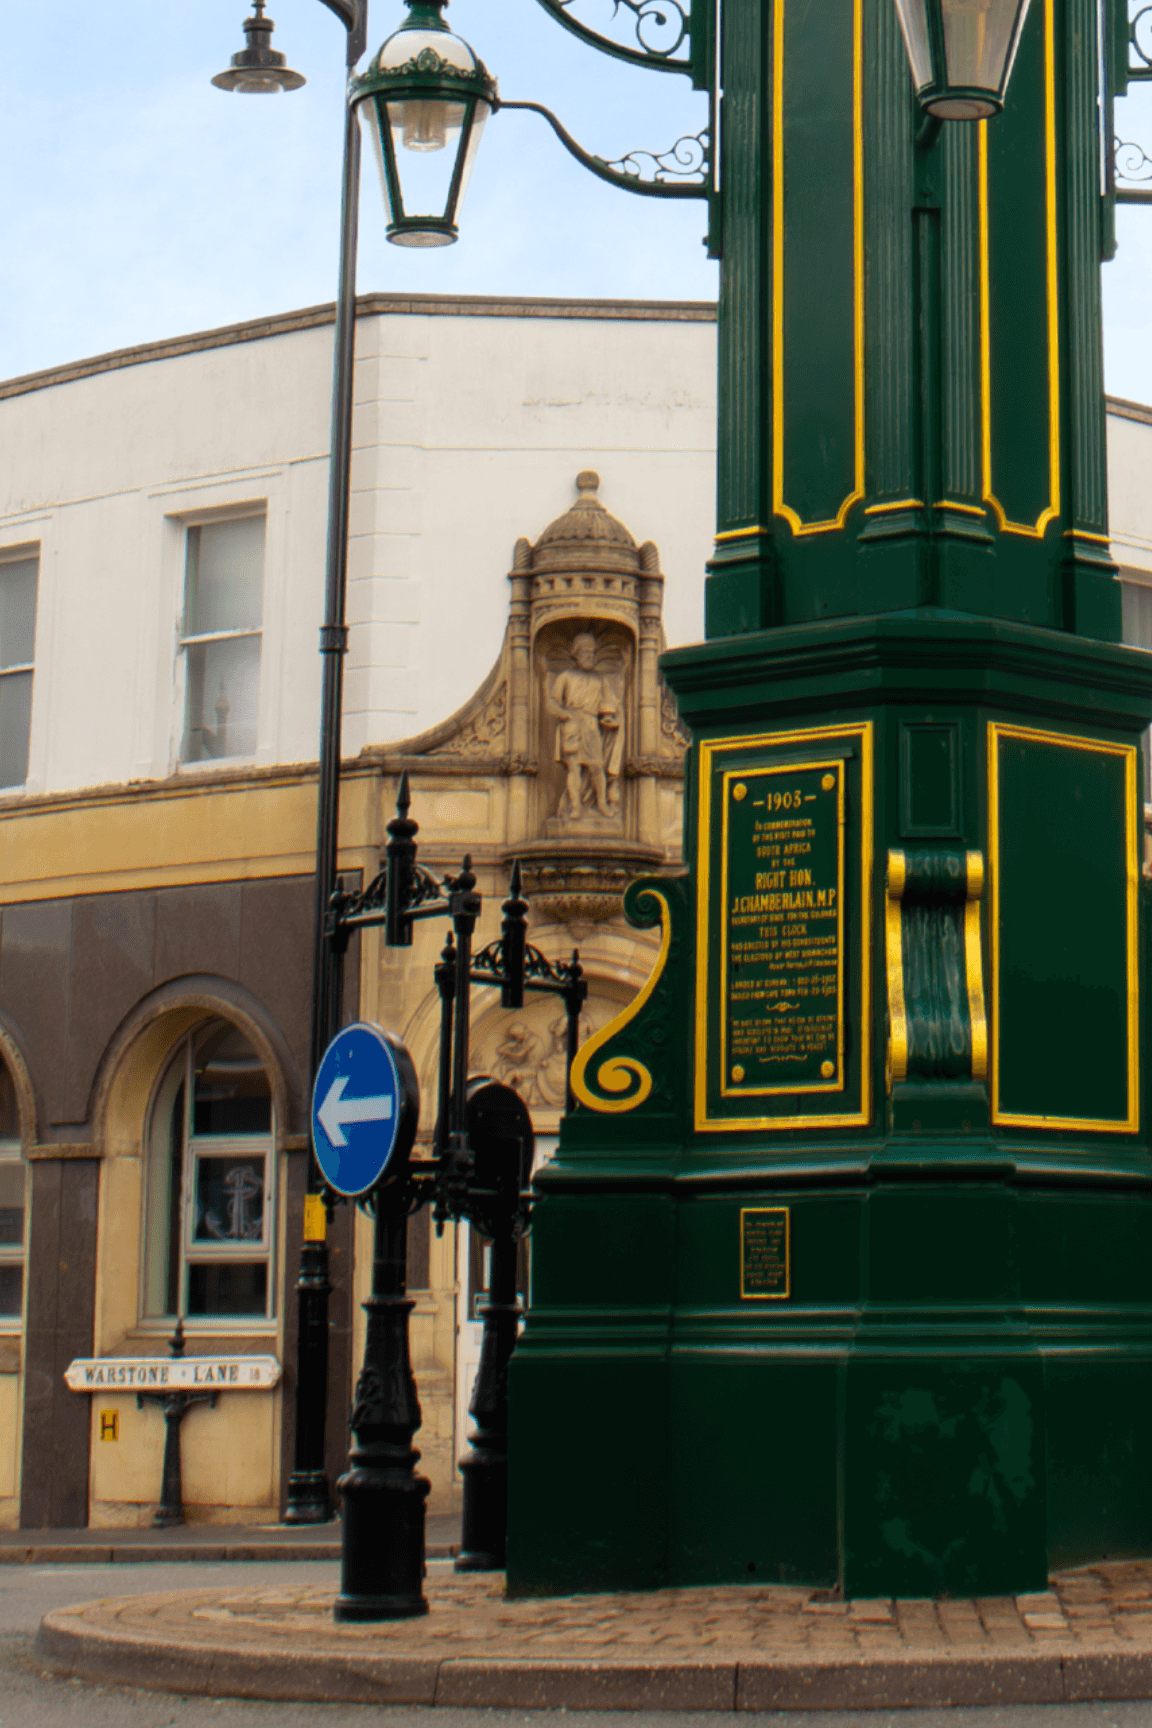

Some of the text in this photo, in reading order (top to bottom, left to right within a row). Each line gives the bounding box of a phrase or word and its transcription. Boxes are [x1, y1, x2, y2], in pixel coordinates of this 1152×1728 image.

[756, 870, 786, 891] RIGHT
[84, 1366, 170, 1384] WARSTONE
[192, 1364, 240, 1384] LANE
[102, 1413, 117, 1440] H
